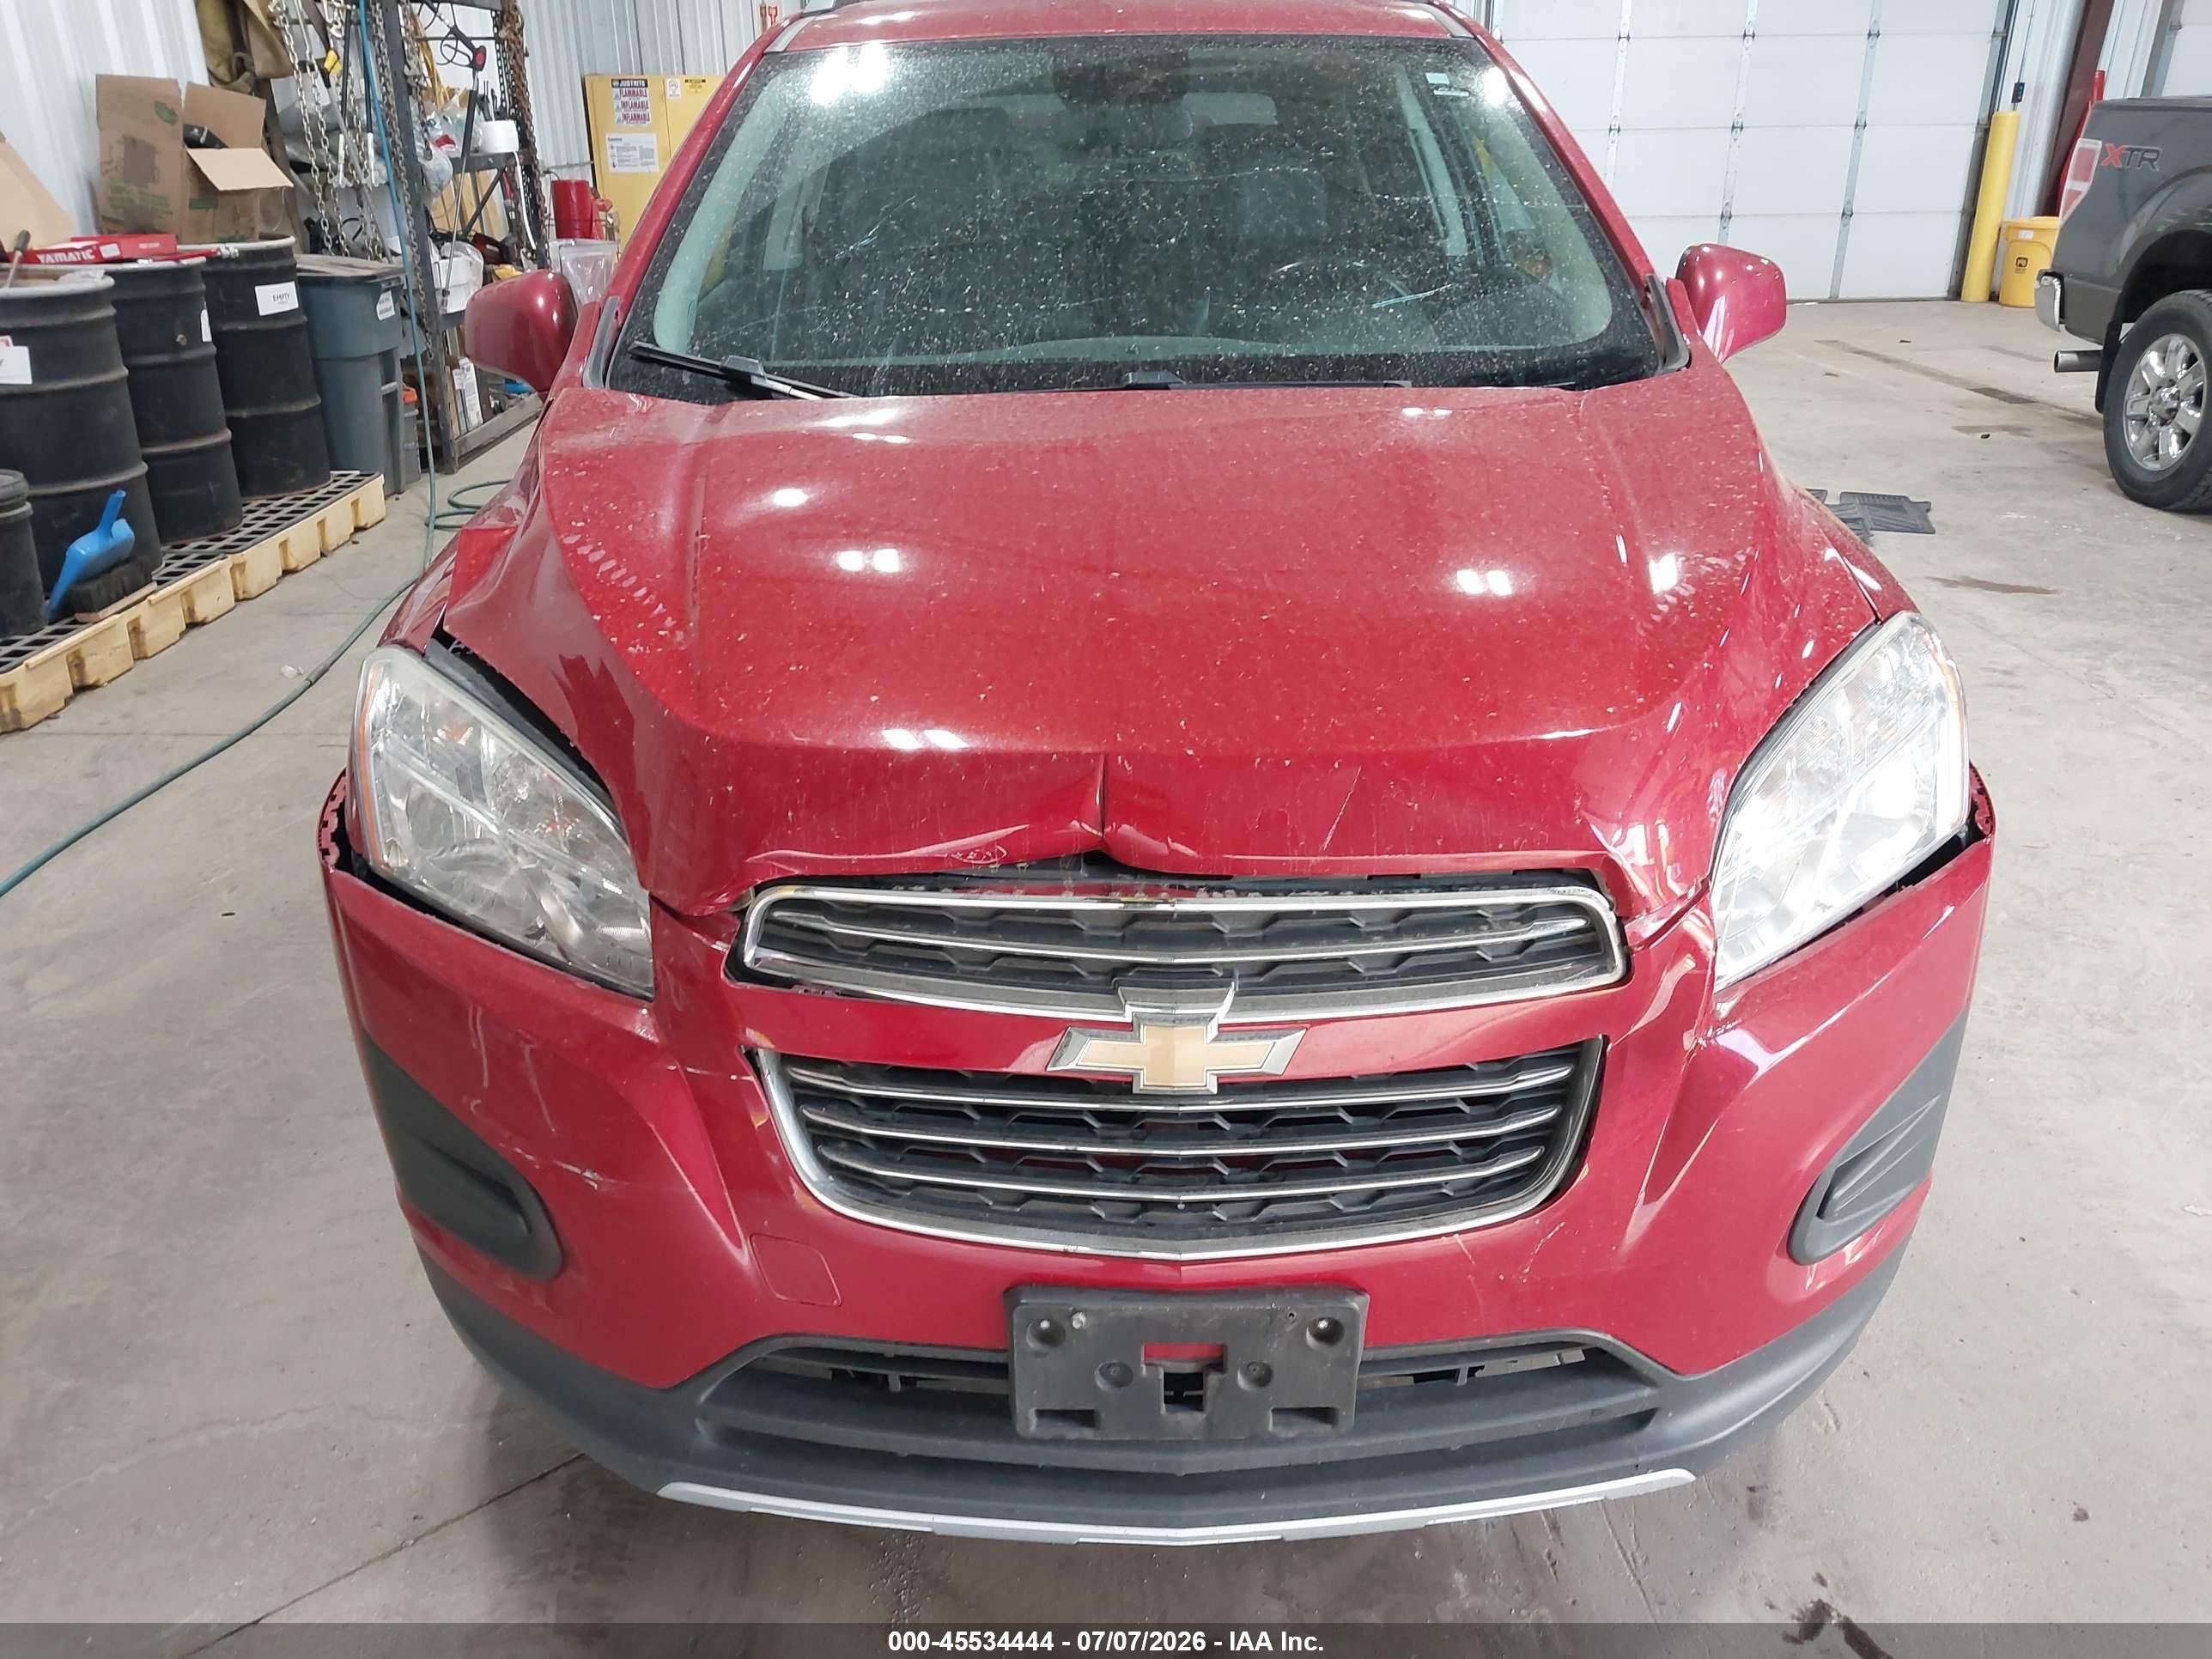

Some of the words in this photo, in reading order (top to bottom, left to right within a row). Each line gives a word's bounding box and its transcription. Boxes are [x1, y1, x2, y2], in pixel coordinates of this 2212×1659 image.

[619, 88, 647, 97] FLAMMABLE
[2100, 143, 2162, 172] XTR
[35, 249, 95, 264] YAMATIC
[272, 293, 289, 302] EMPTY
